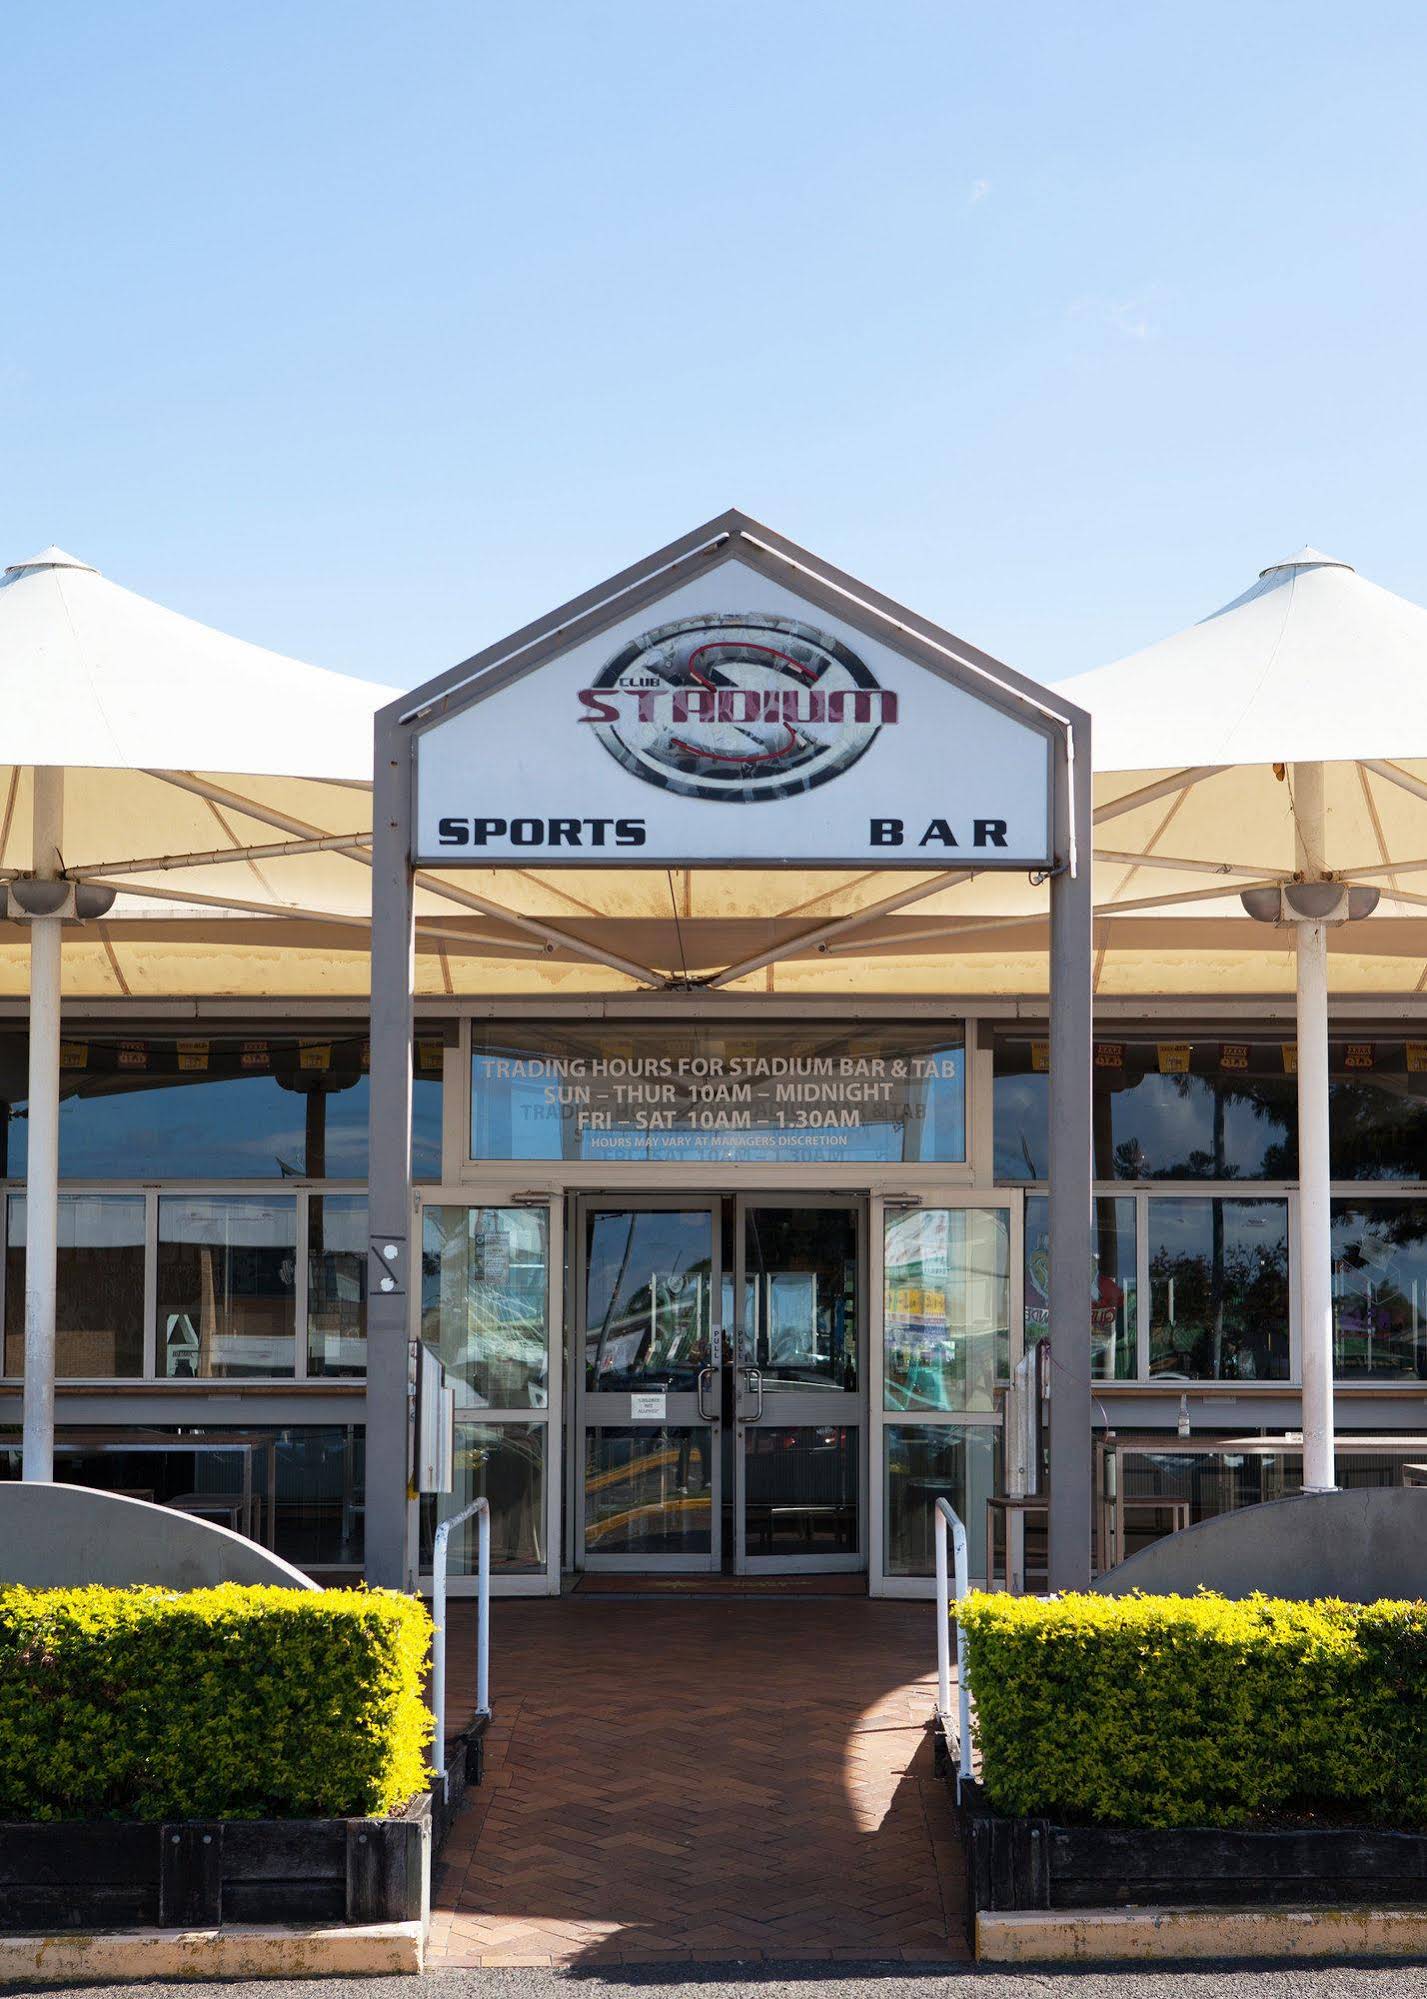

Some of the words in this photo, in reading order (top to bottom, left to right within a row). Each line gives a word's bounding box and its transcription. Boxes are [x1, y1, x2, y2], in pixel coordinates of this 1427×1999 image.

[619, 677, 660, 687] CLUB
[577, 689, 898, 723] STADIUM
[438, 818, 647, 847] SPORTS
[869, 819, 1009, 847] BAR
[480, 1058, 586, 1079] TRADING
[592, 1058, 672, 1077] HOURS
[679, 1058, 724, 1077] FOR
[729, 1057, 833, 1077] STADIUM
[840, 1058, 885, 1077] BAR
[890, 1059, 907, 1077] &
[911, 1060, 956, 1079] TAB
[544, 1085, 591, 1105] SUN
[613, 1085, 676, 1103] THUR
[688, 1084, 751, 1102] 10AM
[776, 1083, 894, 1101] MIDNIGHT
[577, 1112, 612, 1130] FRI
[636, 1111, 676, 1129] SAT
[688, 1110, 751, 1129] 10AM
[776, 1109, 860, 1128] 1.30AM
[591, 1137, 632, 1148] HOURS
[634, 1137, 660, 1147] MAY
[661, 1137, 691, 1147] VARY
[694, 1137, 708, 1146] AT
[778, 1135, 848, 1147] DISCRETION
